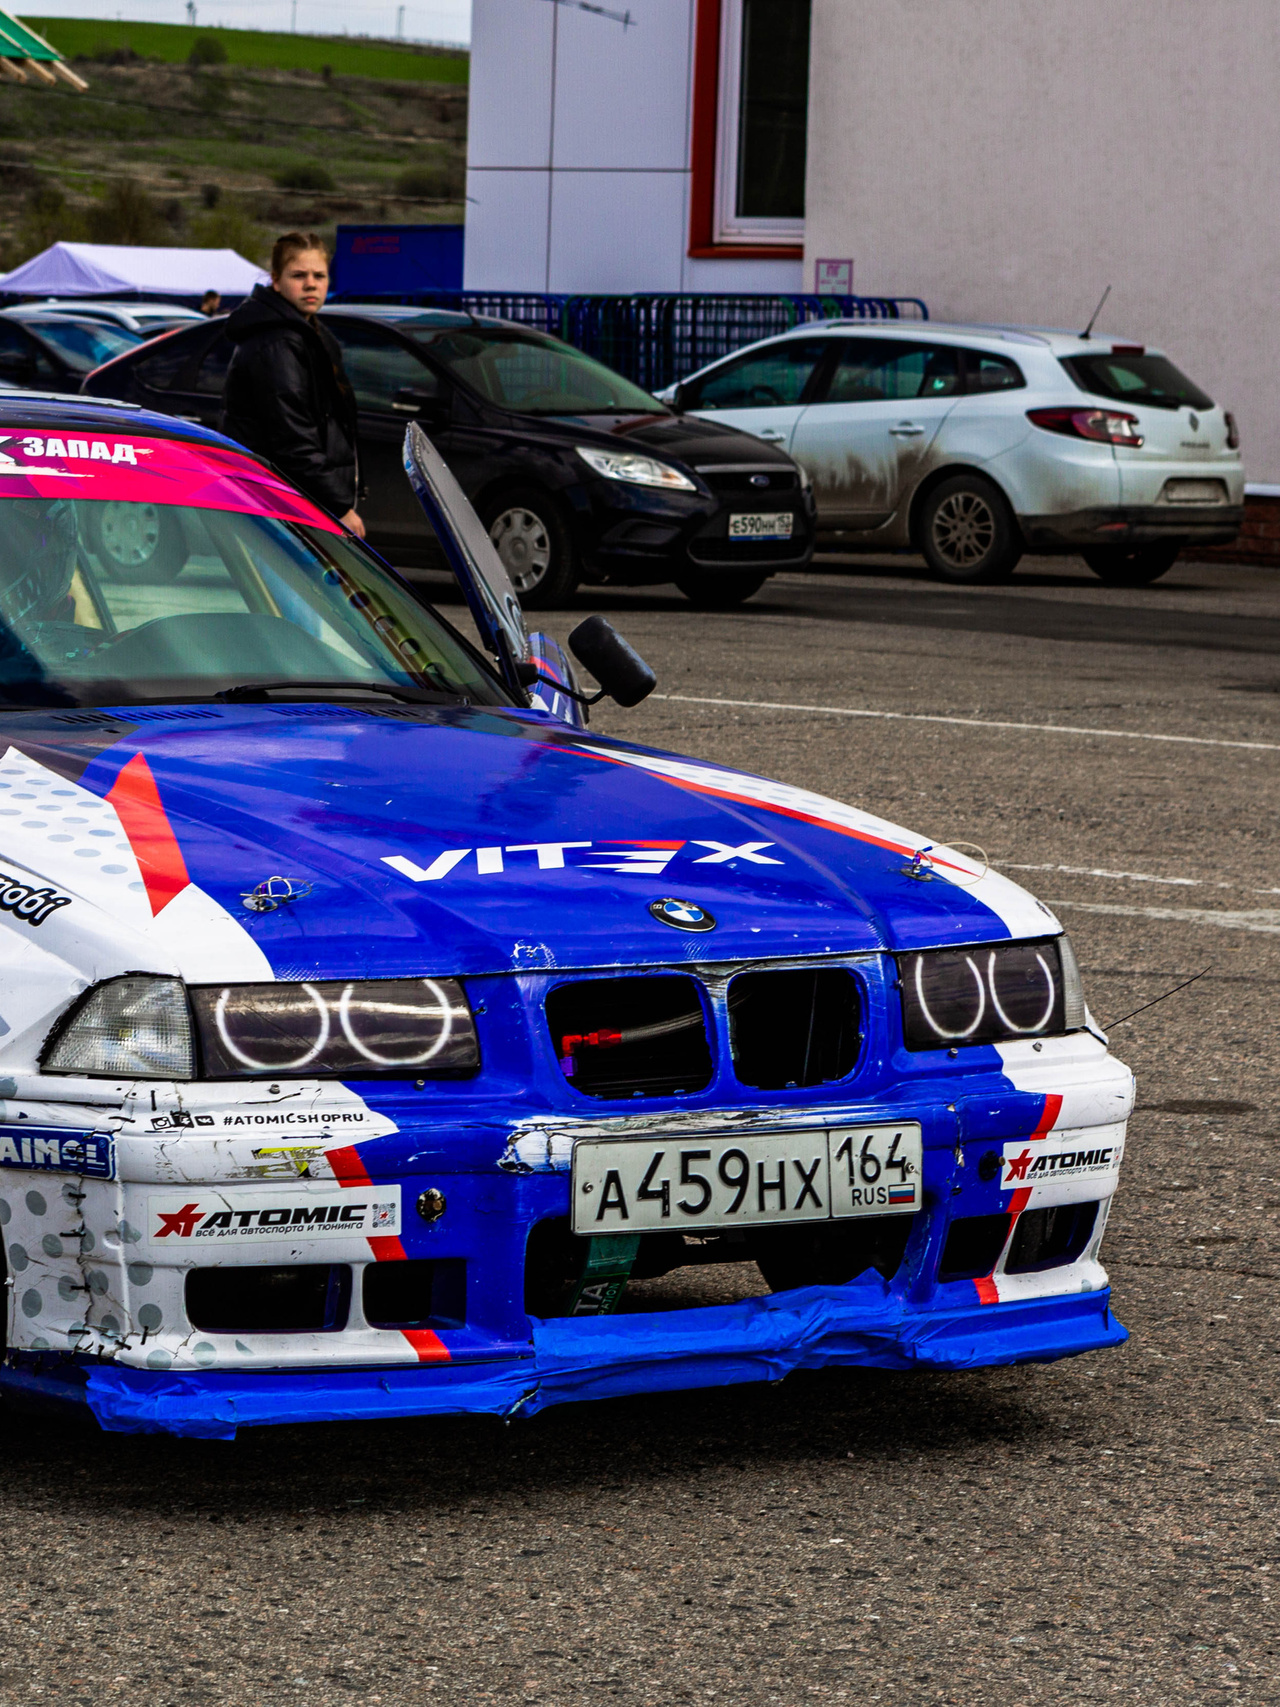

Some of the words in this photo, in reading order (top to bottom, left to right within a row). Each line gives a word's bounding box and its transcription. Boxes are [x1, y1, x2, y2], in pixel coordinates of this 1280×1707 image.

[23, 437, 138, 465] ЗАПАД
[380, 840, 785, 882] VITEX
[223, 1113, 364, 1126] #ATOMICSHOPRU
[834, 1133, 908, 1187] 164
[1030, 1148, 1113, 1173] ATOMIC
[852, 1188, 888, 1207] RUS
[200, 1205, 368, 1229] ATOMIC
[217, 1228, 238, 1237] для
[240, 1224, 305, 1235] автоспорта
[317, 1221, 363, 1231] тюнинга
